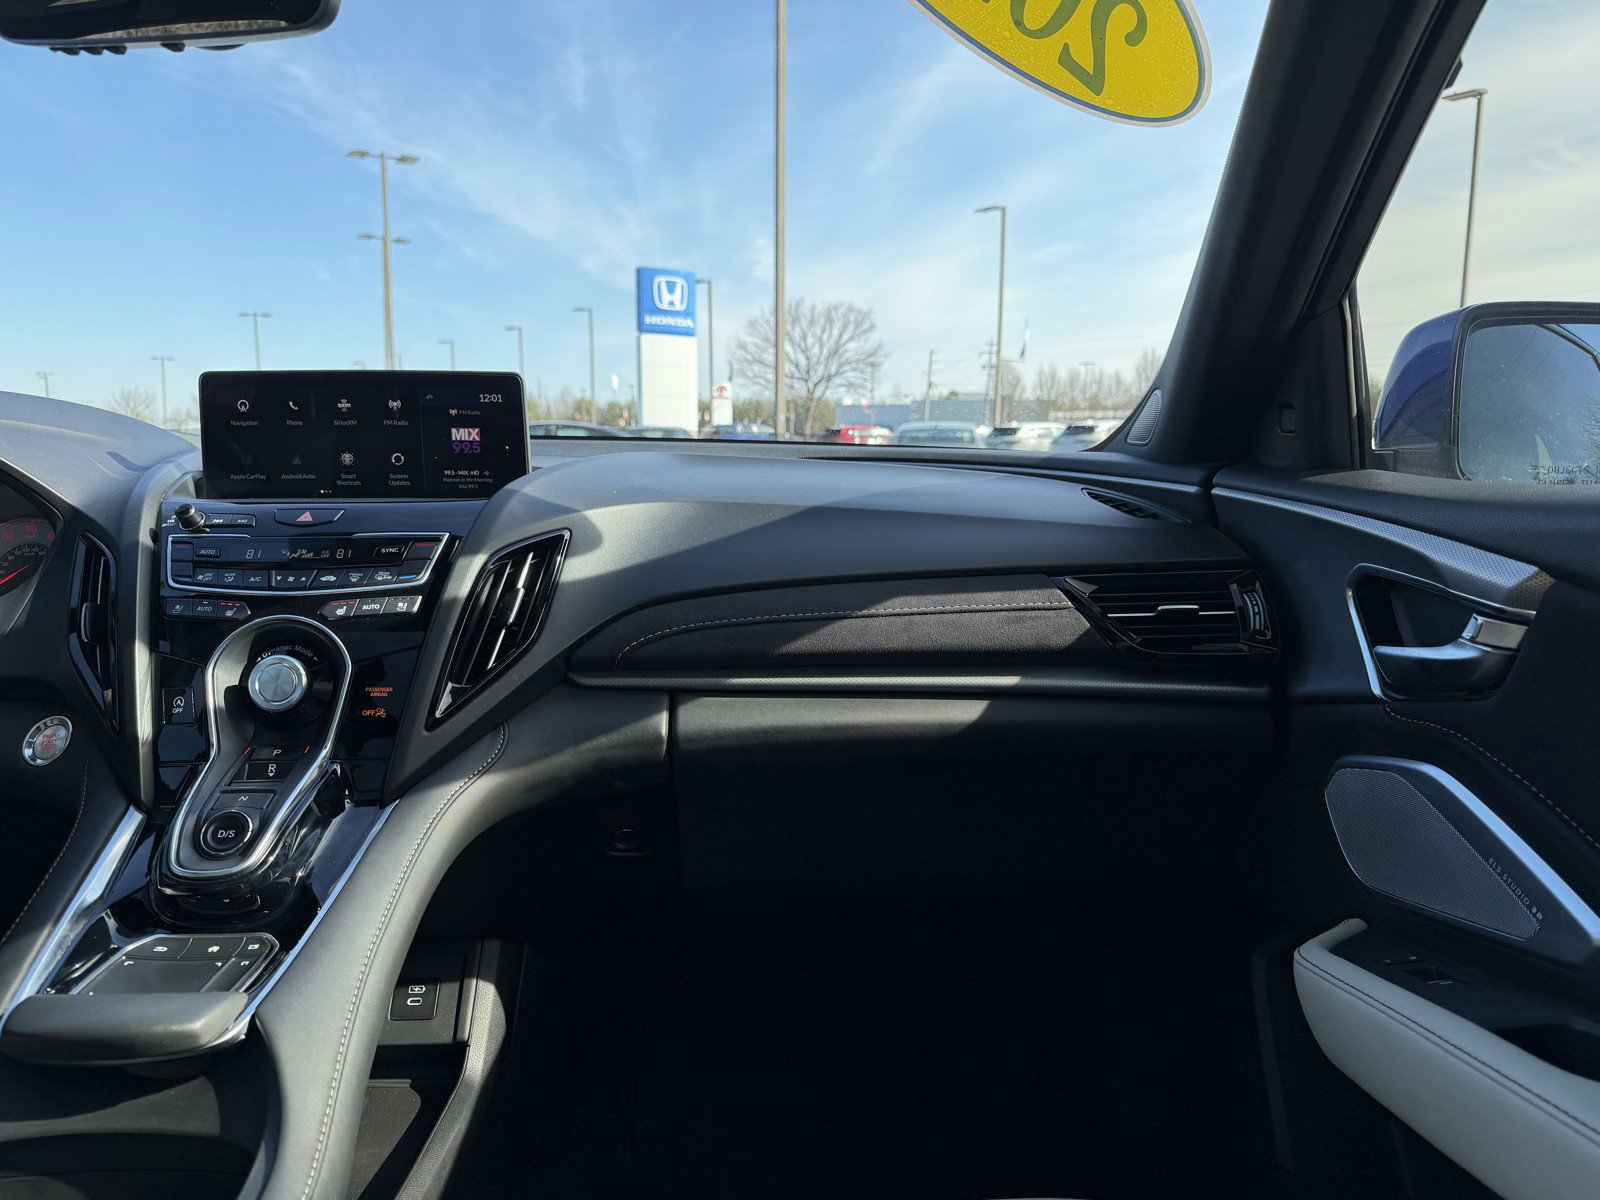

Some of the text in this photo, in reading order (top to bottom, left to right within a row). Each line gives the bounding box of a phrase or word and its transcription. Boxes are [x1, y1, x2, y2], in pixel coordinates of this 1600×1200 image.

[643, 314, 694, 328] HONDA
[480, 394, 503, 402] 12:01
[451, 428, 480, 440] MIX
[452, 442, 481, 453] 99.5
[1548, 466, 1589, 474] OBJECTS
[246, 550, 261, 559] 81
[336, 549, 352, 558] 81
[262, 644, 313, 658] Dynamic Mode
[268, 764, 276, 772] R
[1488, 858, 1542, 919] ELS STUDIO 3D
